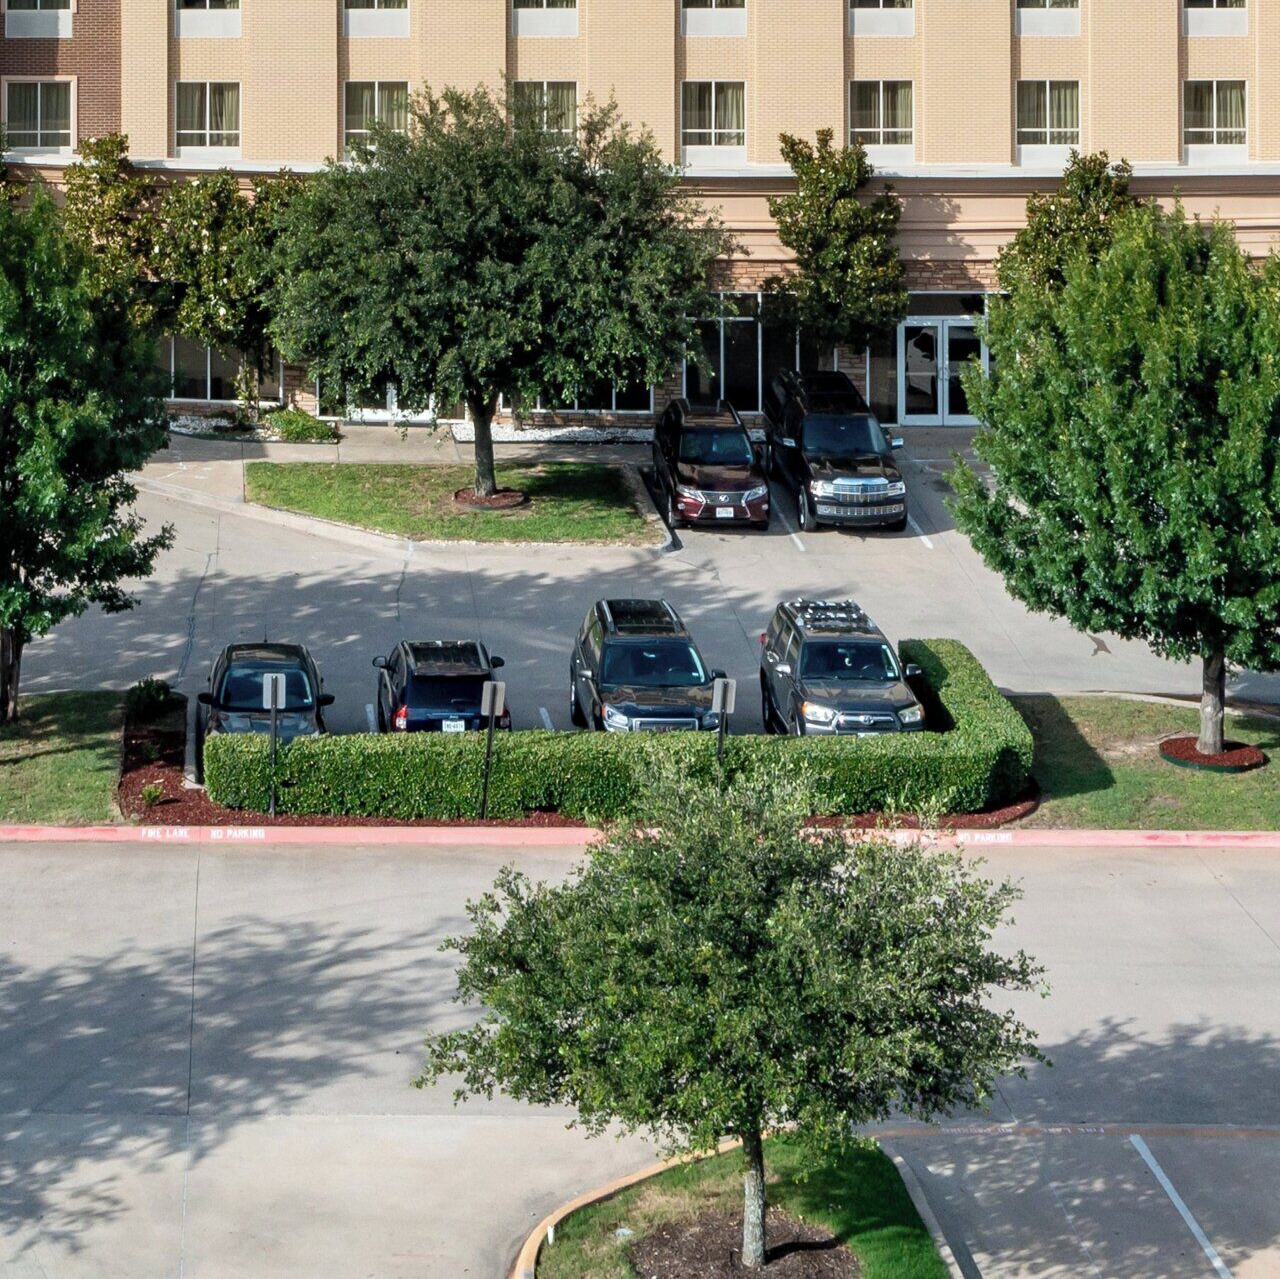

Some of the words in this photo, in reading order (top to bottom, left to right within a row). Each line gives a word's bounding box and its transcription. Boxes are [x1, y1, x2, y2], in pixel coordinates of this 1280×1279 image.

[141, 827, 162, 839] FIRE
[166, 828, 189, 839] LANE
[210, 829, 223, 840] NO
[227, 829, 265, 840] PARKING
[974, 832, 1013, 842] PARKING
